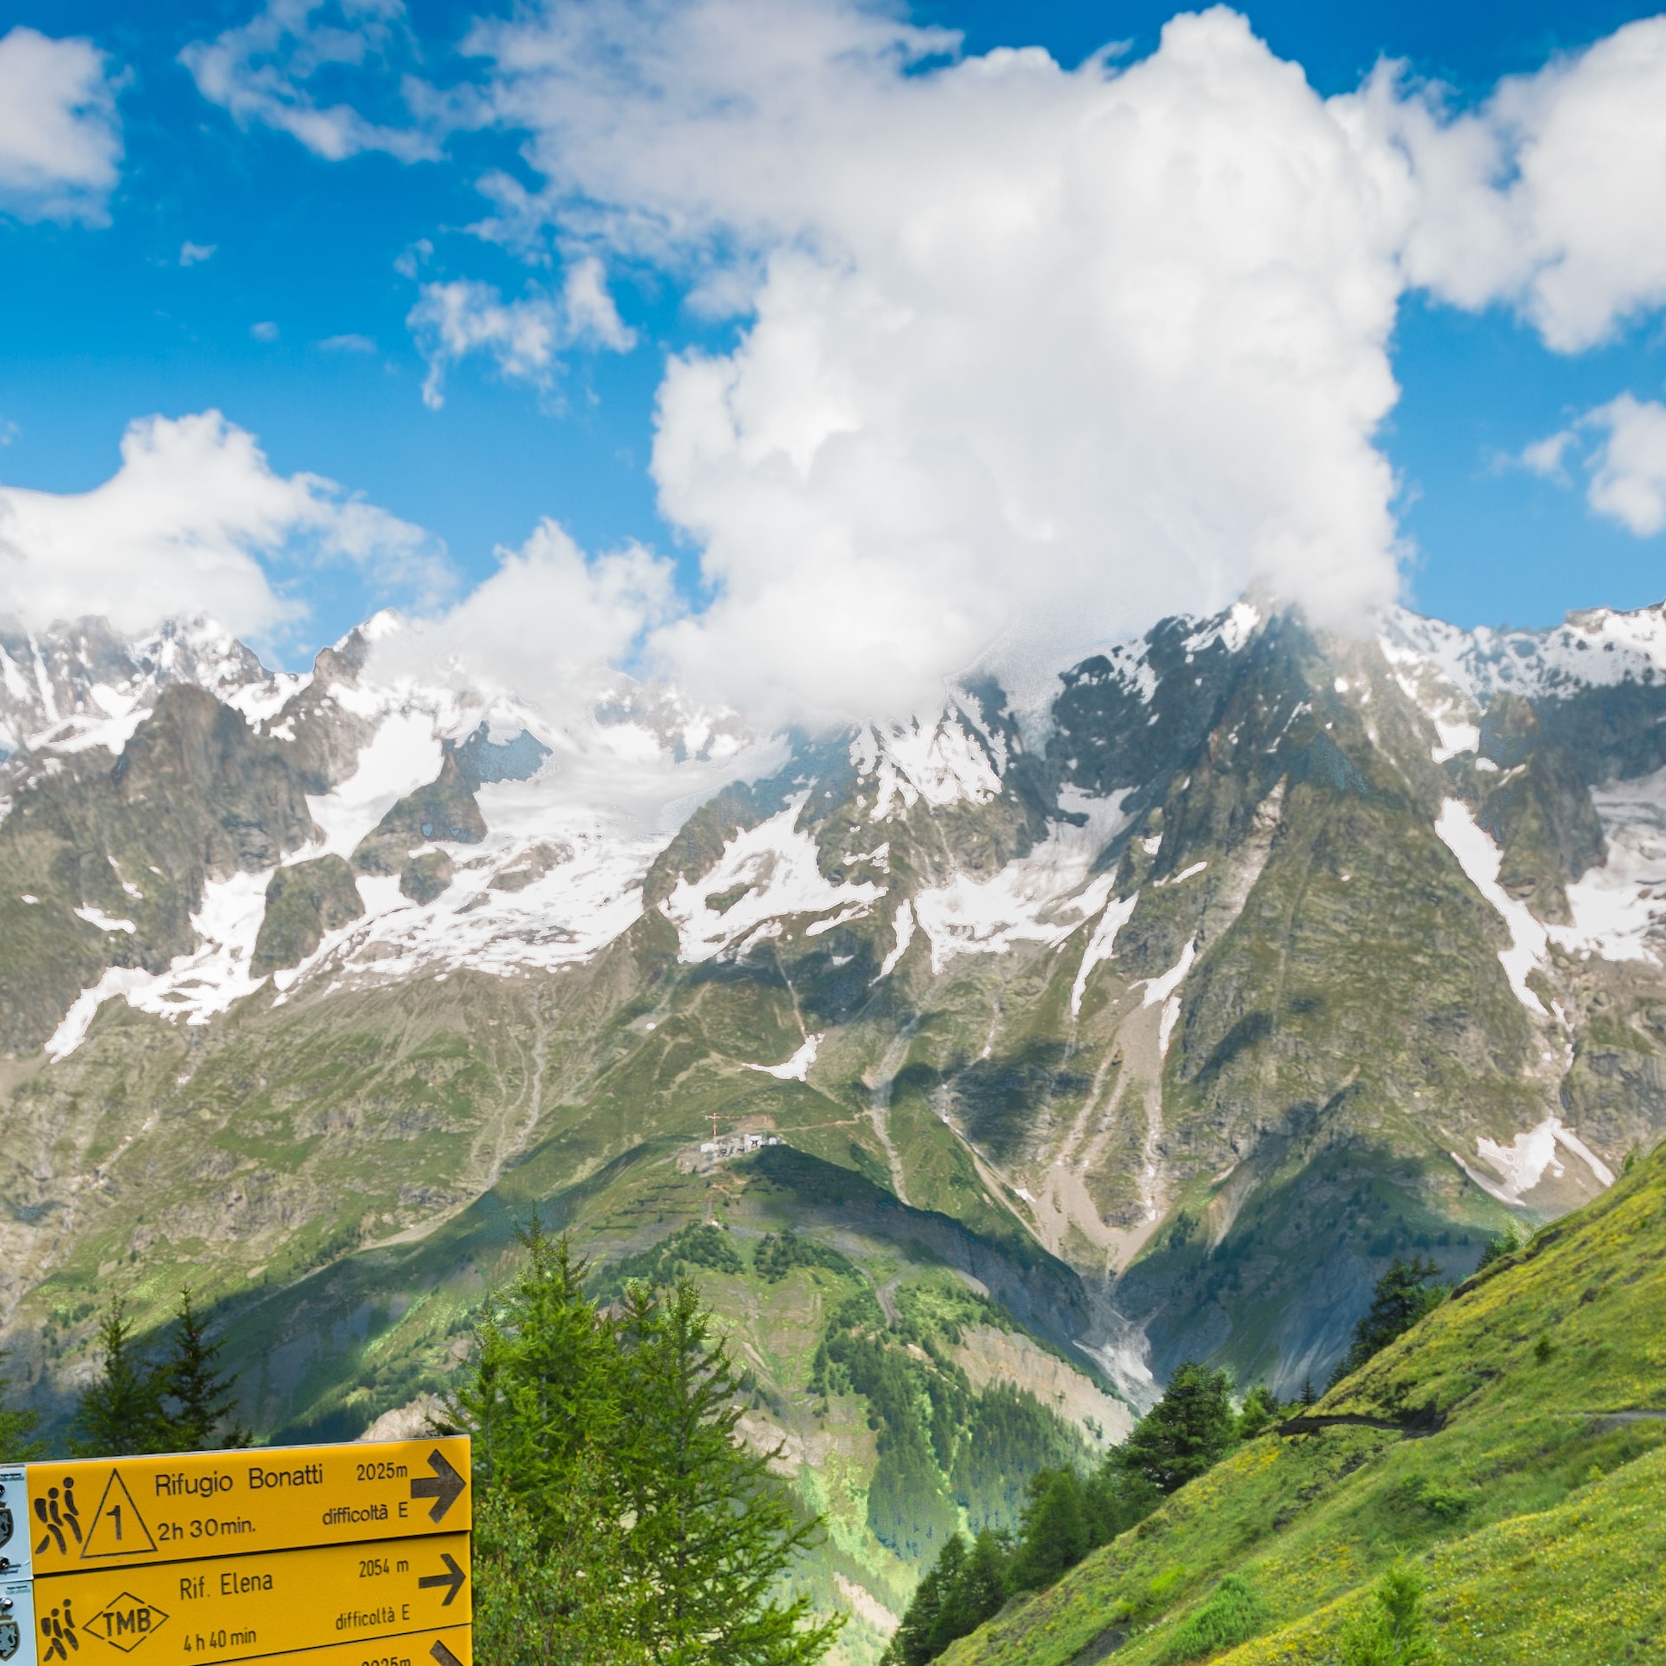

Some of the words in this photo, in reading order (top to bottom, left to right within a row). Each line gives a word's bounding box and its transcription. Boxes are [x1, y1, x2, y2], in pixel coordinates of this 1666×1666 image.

[155, 1470, 233, 1498] Rifugio
[249, 1463, 323, 1489] Bonatti
[356, 1462, 408, 1481] 2025m
[106, 1505, 121, 1540] 1
[322, 1504, 389, 1525] difficoltà
[399, 1501, 408, 1518] E
[157, 1521, 184, 1541] 2h
[359, 1558, 390, 1578] 2054
[396, 1559, 409, 1573] m
[180, 1576, 211, 1600] Rif.
[220, 1573, 274, 1596] Elena
[103, 1608, 151, 1637] TMB
[336, 1606, 395, 1630] difficoltà
[402, 1604, 410, 1621] E
